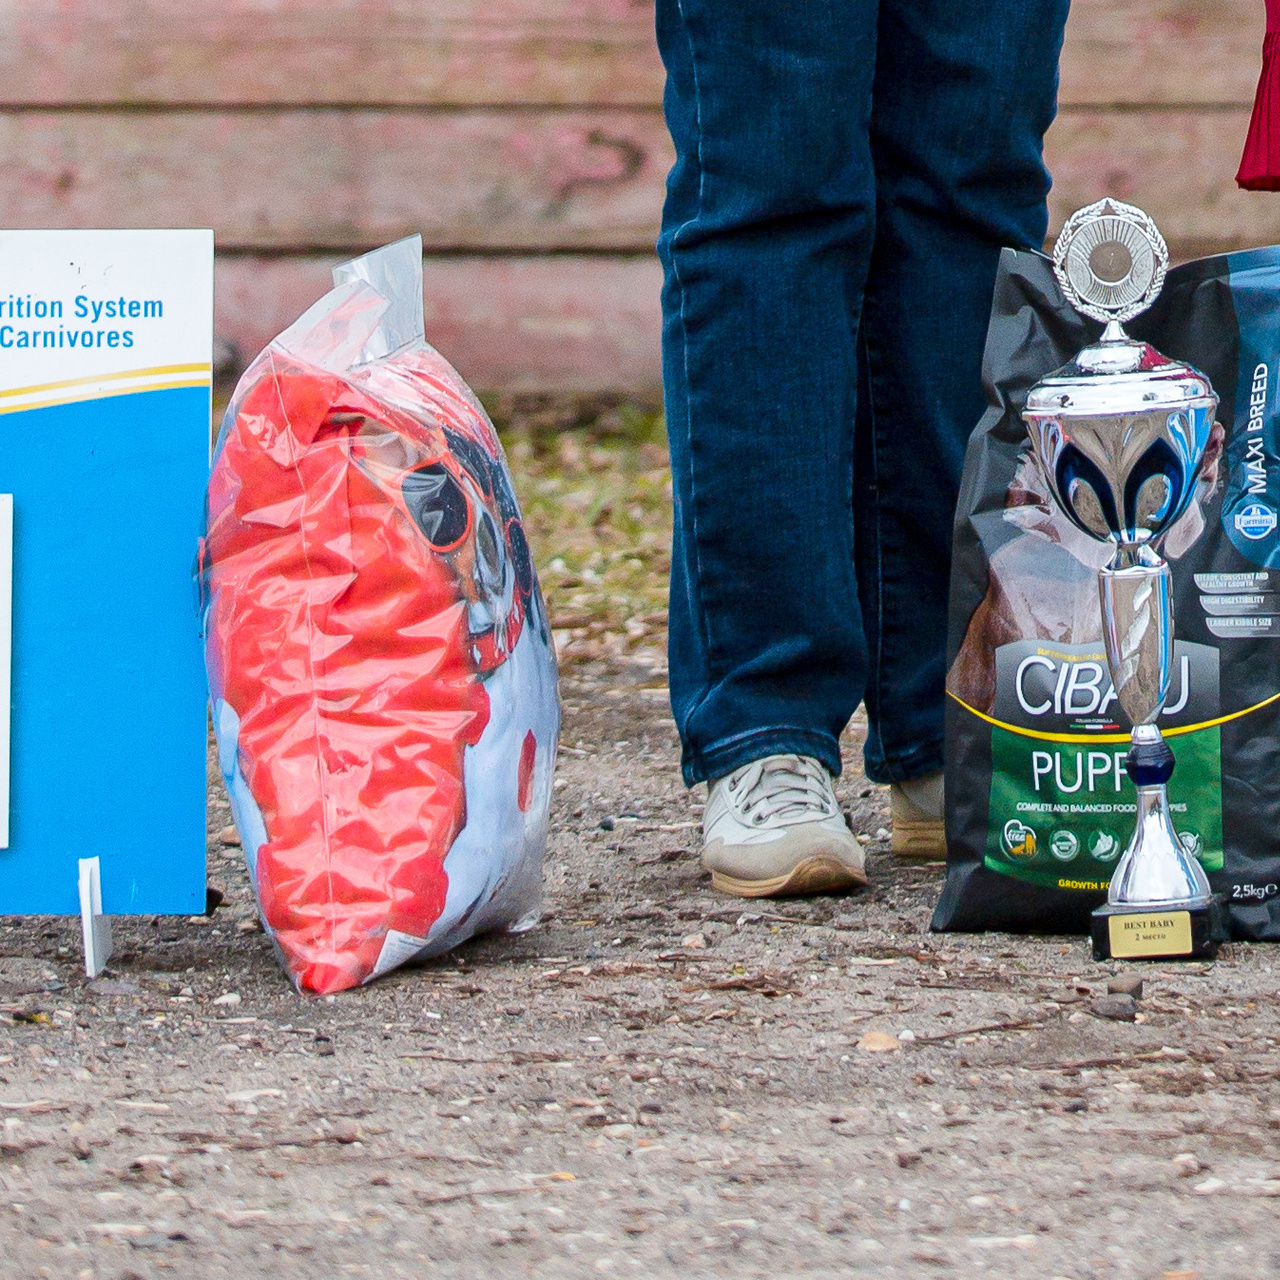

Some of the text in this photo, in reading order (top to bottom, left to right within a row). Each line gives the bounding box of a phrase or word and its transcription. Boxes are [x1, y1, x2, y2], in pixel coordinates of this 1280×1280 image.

[0, 294, 164, 324] rition System
[0, 324, 134, 348] Carnivores
[1246, 362, 1269, 494] MAXI BREED
[1016, 802, 1052, 812] COMPLETE
[1053, 803, 1069, 813] AND
[1070, 803, 1112, 813] BALANCED
[1113, 803, 1138, 813] FOOD
[1058, 878, 1098, 890] GROWTH
[1124, 919, 1175, 930] BEST BABY
[1135, 933, 1140, 941] 2
